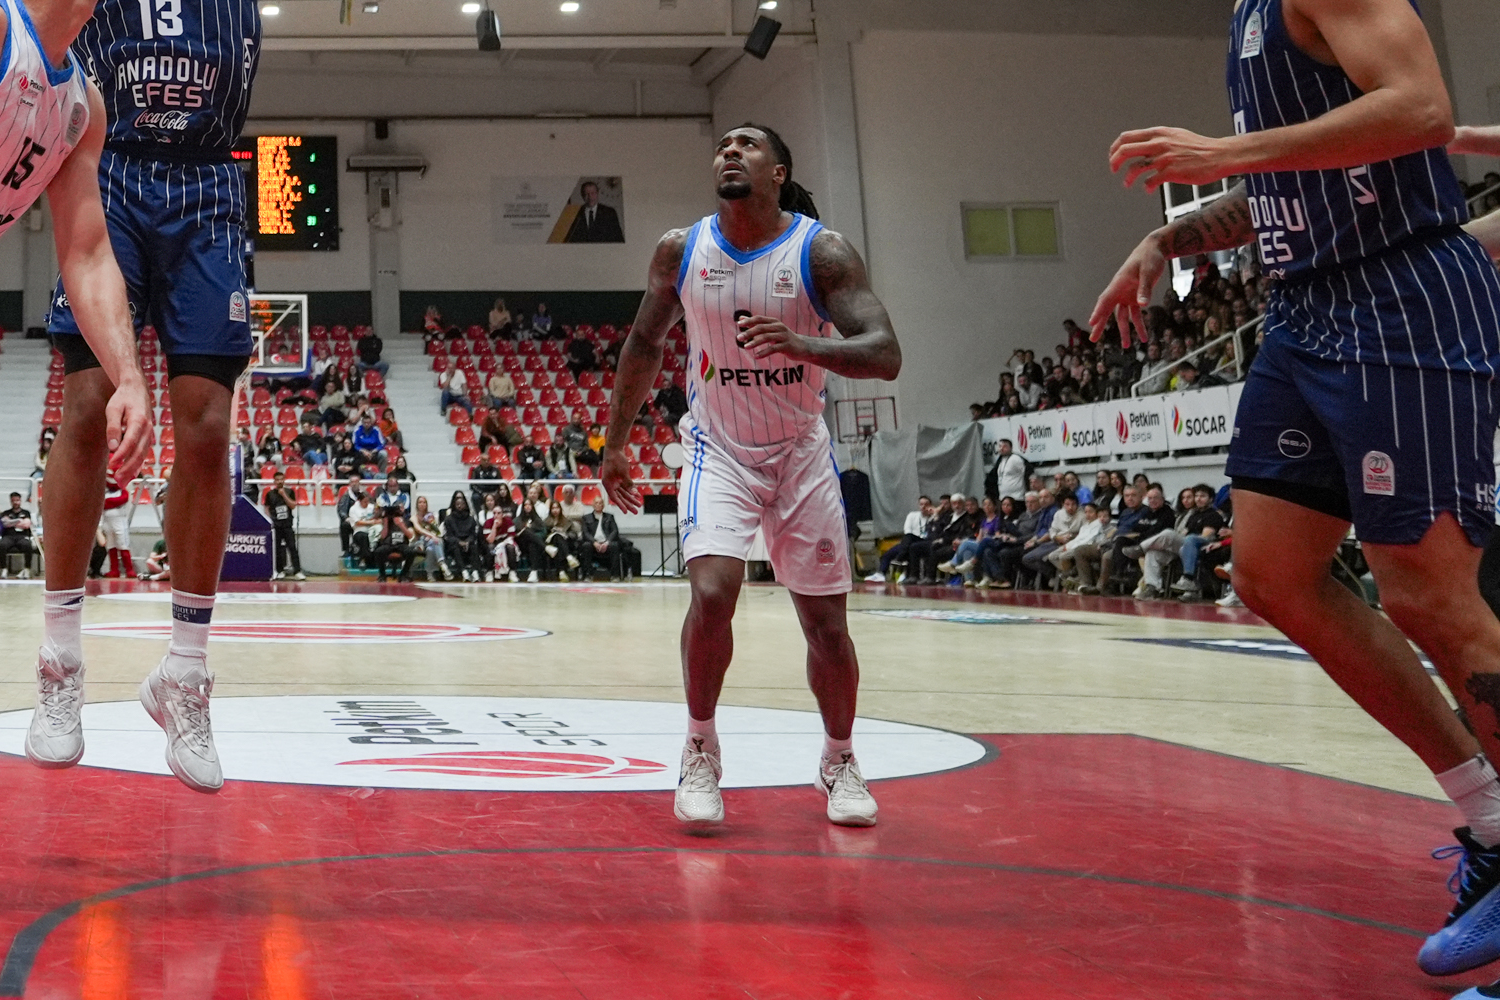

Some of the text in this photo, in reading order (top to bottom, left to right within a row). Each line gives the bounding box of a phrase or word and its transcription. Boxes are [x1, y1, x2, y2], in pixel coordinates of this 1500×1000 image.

[117, 55, 217, 91] ANADOLU
[131, 82, 203, 108] EFES
[1, 136, 46, 190] 15
[1129, 410, 1160, 428] Petkim
[1185, 415, 1226, 437] SOCAR
[1028, 425, 1052, 440] Petkim
[1072, 429, 1105, 448] SOCAR
